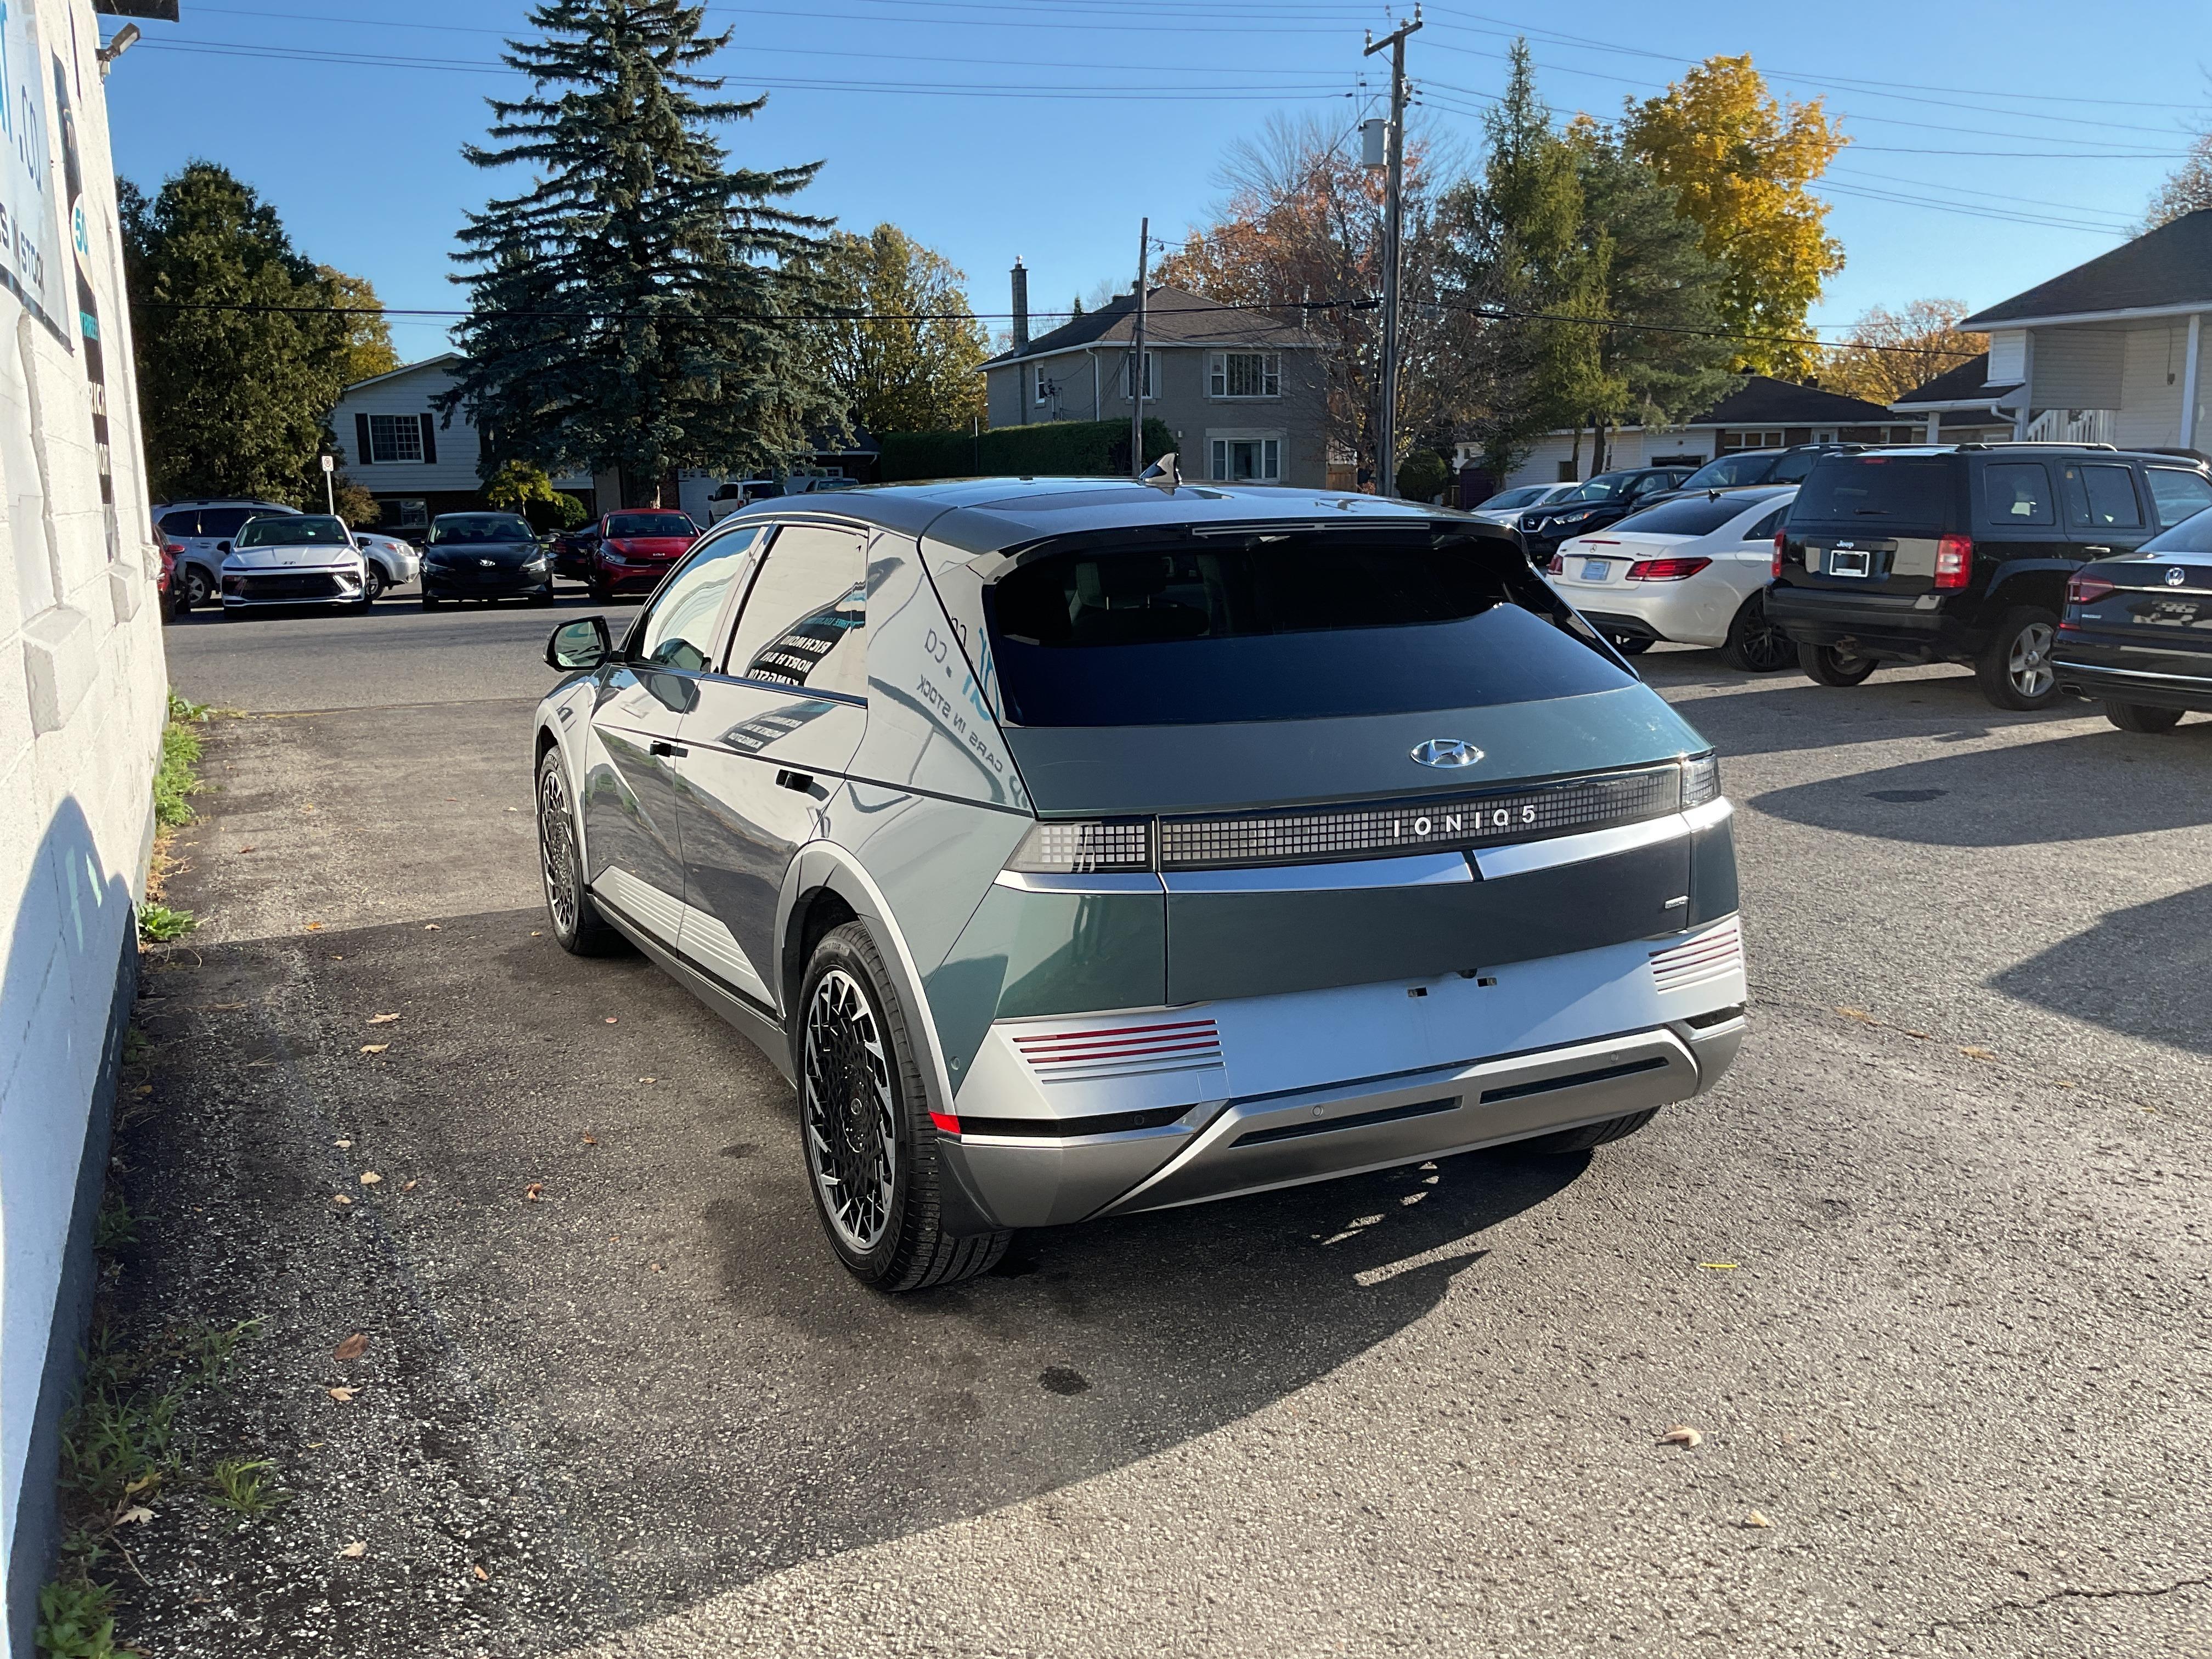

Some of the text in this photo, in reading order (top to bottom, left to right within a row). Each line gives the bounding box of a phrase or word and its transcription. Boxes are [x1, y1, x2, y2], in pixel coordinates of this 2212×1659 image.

[20, 230, 45, 296] STOCK
[1393, 804, 1535, 838] IONIQ 5
